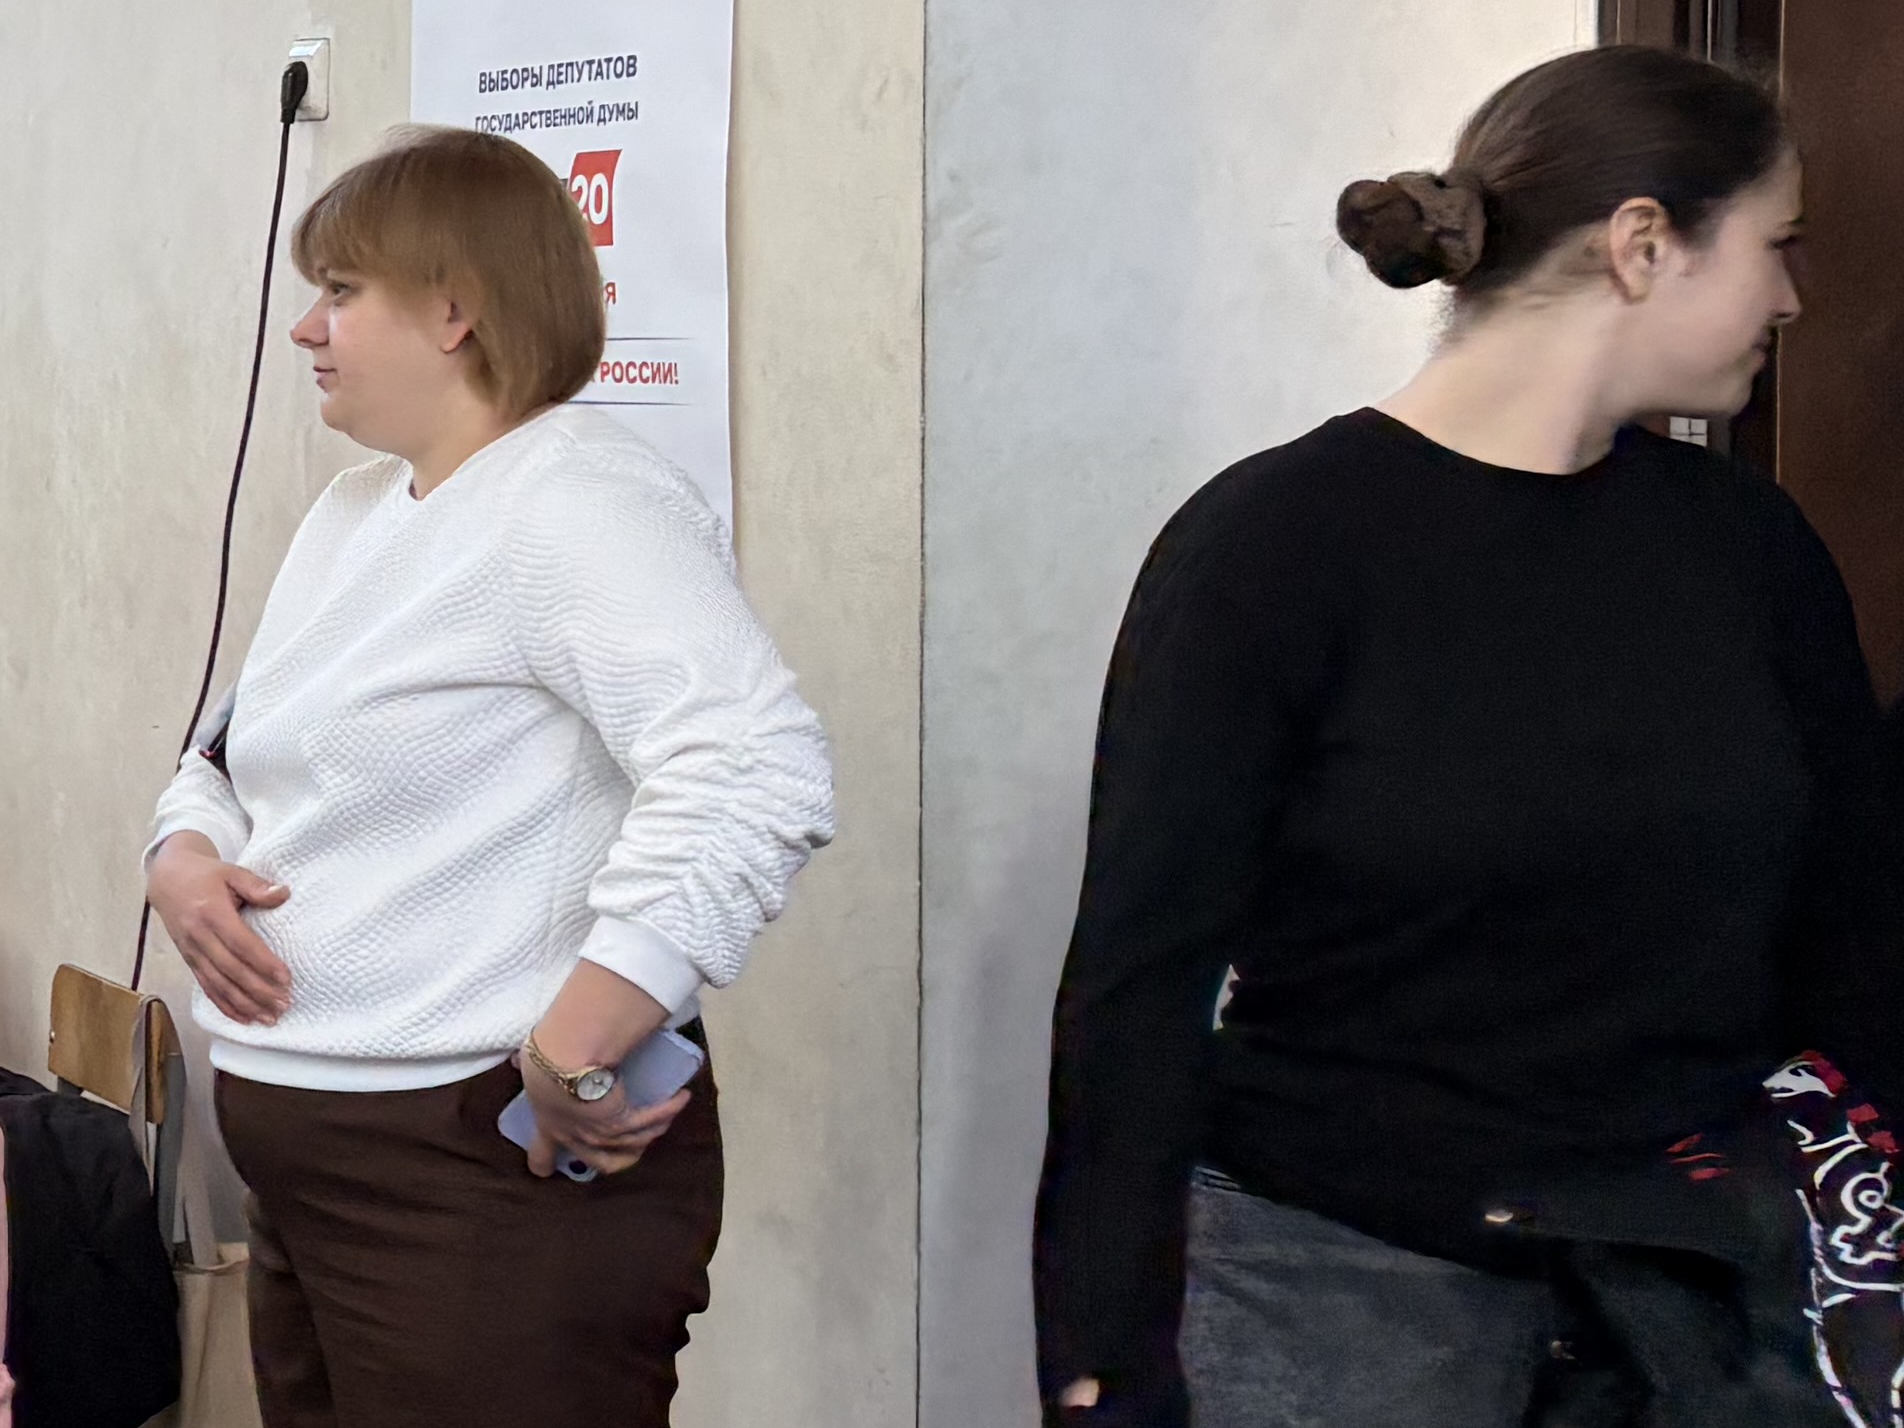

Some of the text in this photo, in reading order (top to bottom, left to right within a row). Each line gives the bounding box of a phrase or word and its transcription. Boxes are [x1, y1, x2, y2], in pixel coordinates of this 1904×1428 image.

[478, 54, 638, 94] ВЫБОРЫ ДЕПУТАТОВ
[474, 99, 639, 134] ГОСУДАРСТВЕННОЙ ДУМЫ
[571, 172, 609, 225] 20
[599, 360, 680, 385] РОССИИ!
